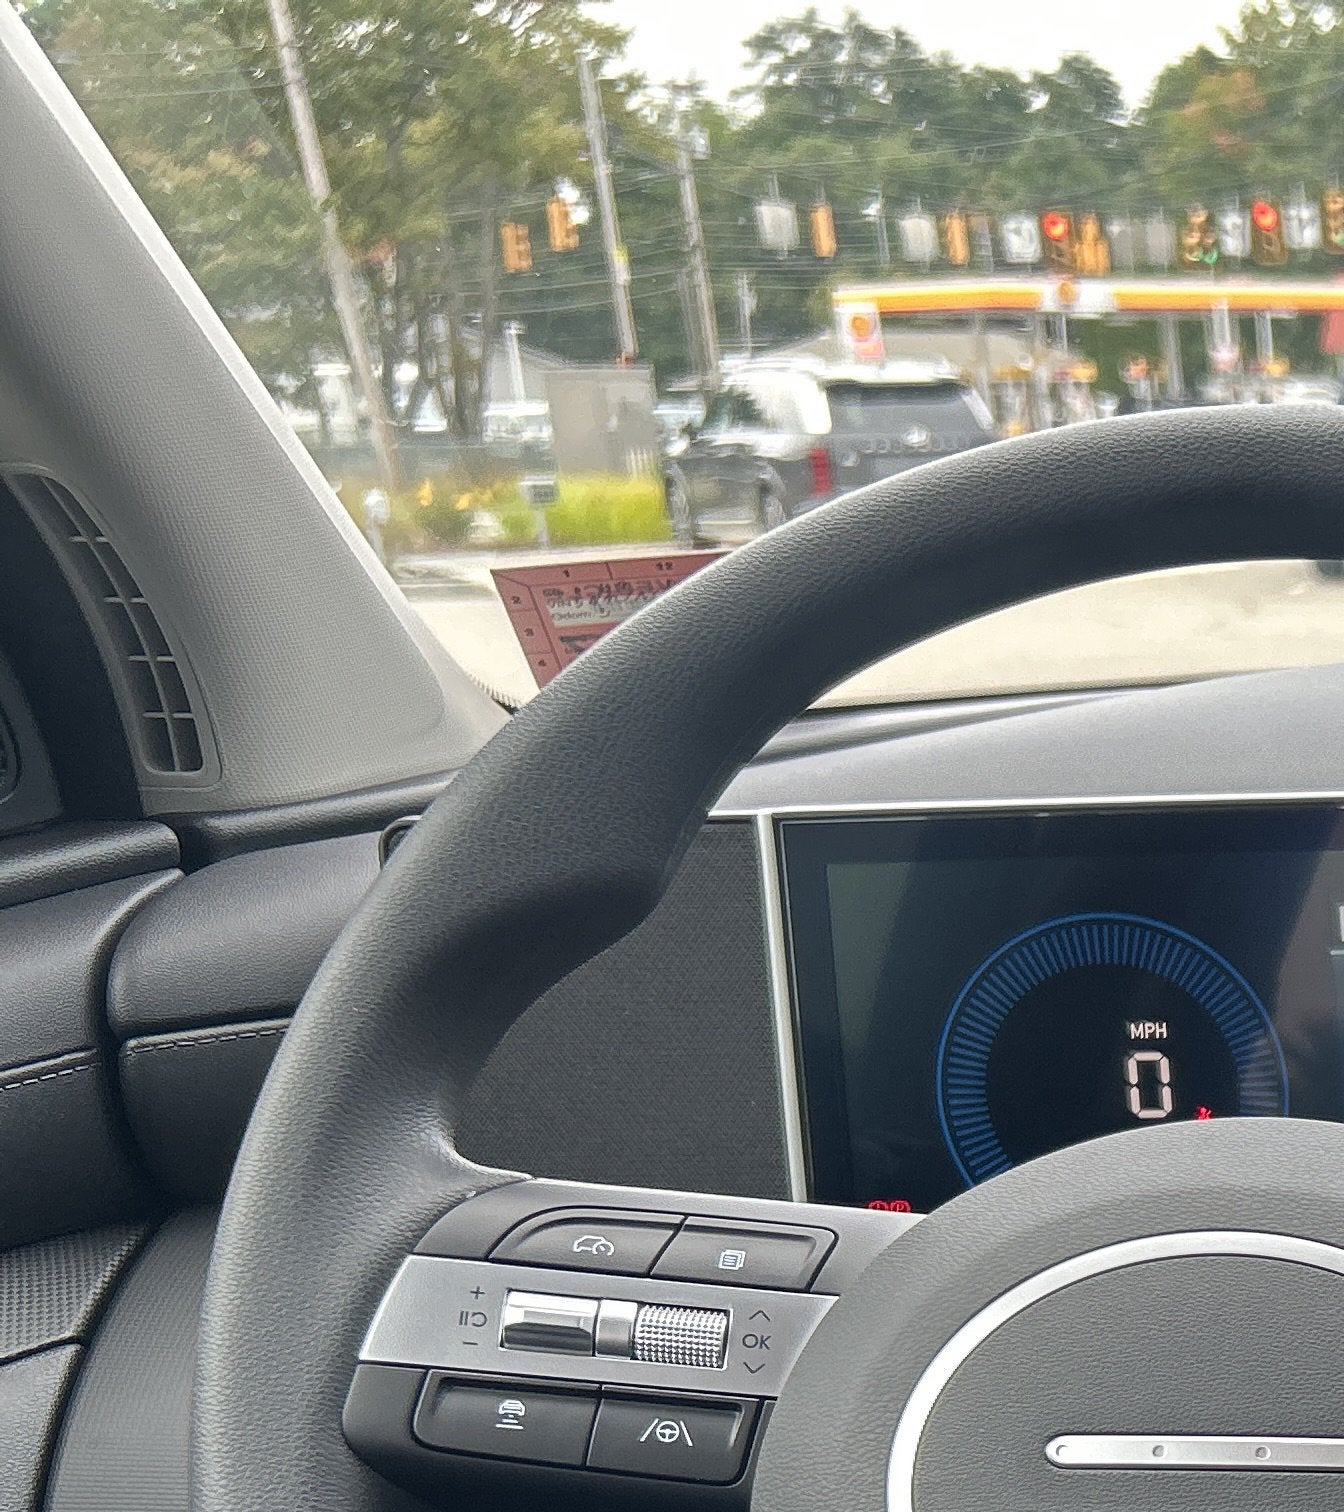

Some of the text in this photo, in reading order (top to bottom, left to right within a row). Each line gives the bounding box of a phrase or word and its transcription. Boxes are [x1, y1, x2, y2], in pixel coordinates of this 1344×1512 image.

[1131, 1022, 1167, 1040] MPH
[1128, 1052, 1172, 1119] 0
[742, 1334, 770, 1352] OK
